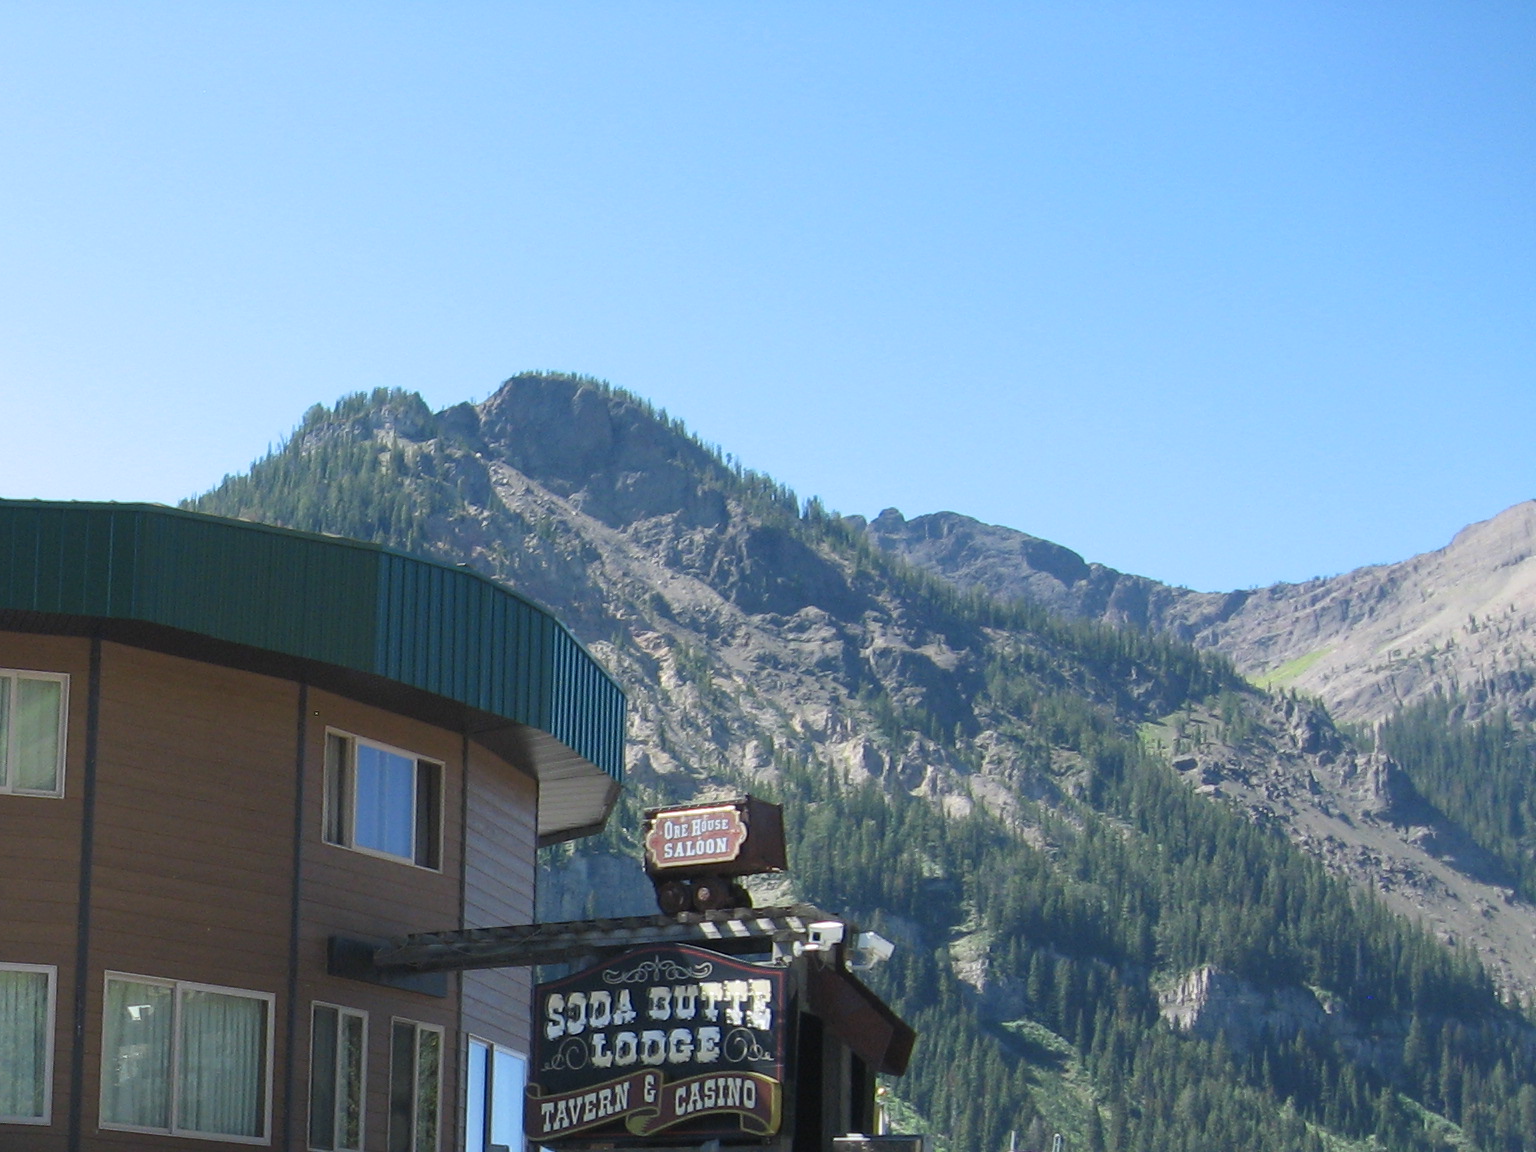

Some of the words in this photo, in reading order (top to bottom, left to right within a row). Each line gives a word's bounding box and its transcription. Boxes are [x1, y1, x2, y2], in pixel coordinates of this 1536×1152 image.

[664, 819, 688, 841] ORE
[691, 816, 730, 837] HOUSE
[664, 836, 728, 859] SALOON
[545, 987, 635, 1040] SODA
[648, 979, 773, 1031] BUTTE
[591, 1026, 722, 1068] LODGE
[541, 1081, 631, 1134] TAVERN
[644, 1074, 657, 1102] &
[675, 1077, 757, 1116] CASINO
